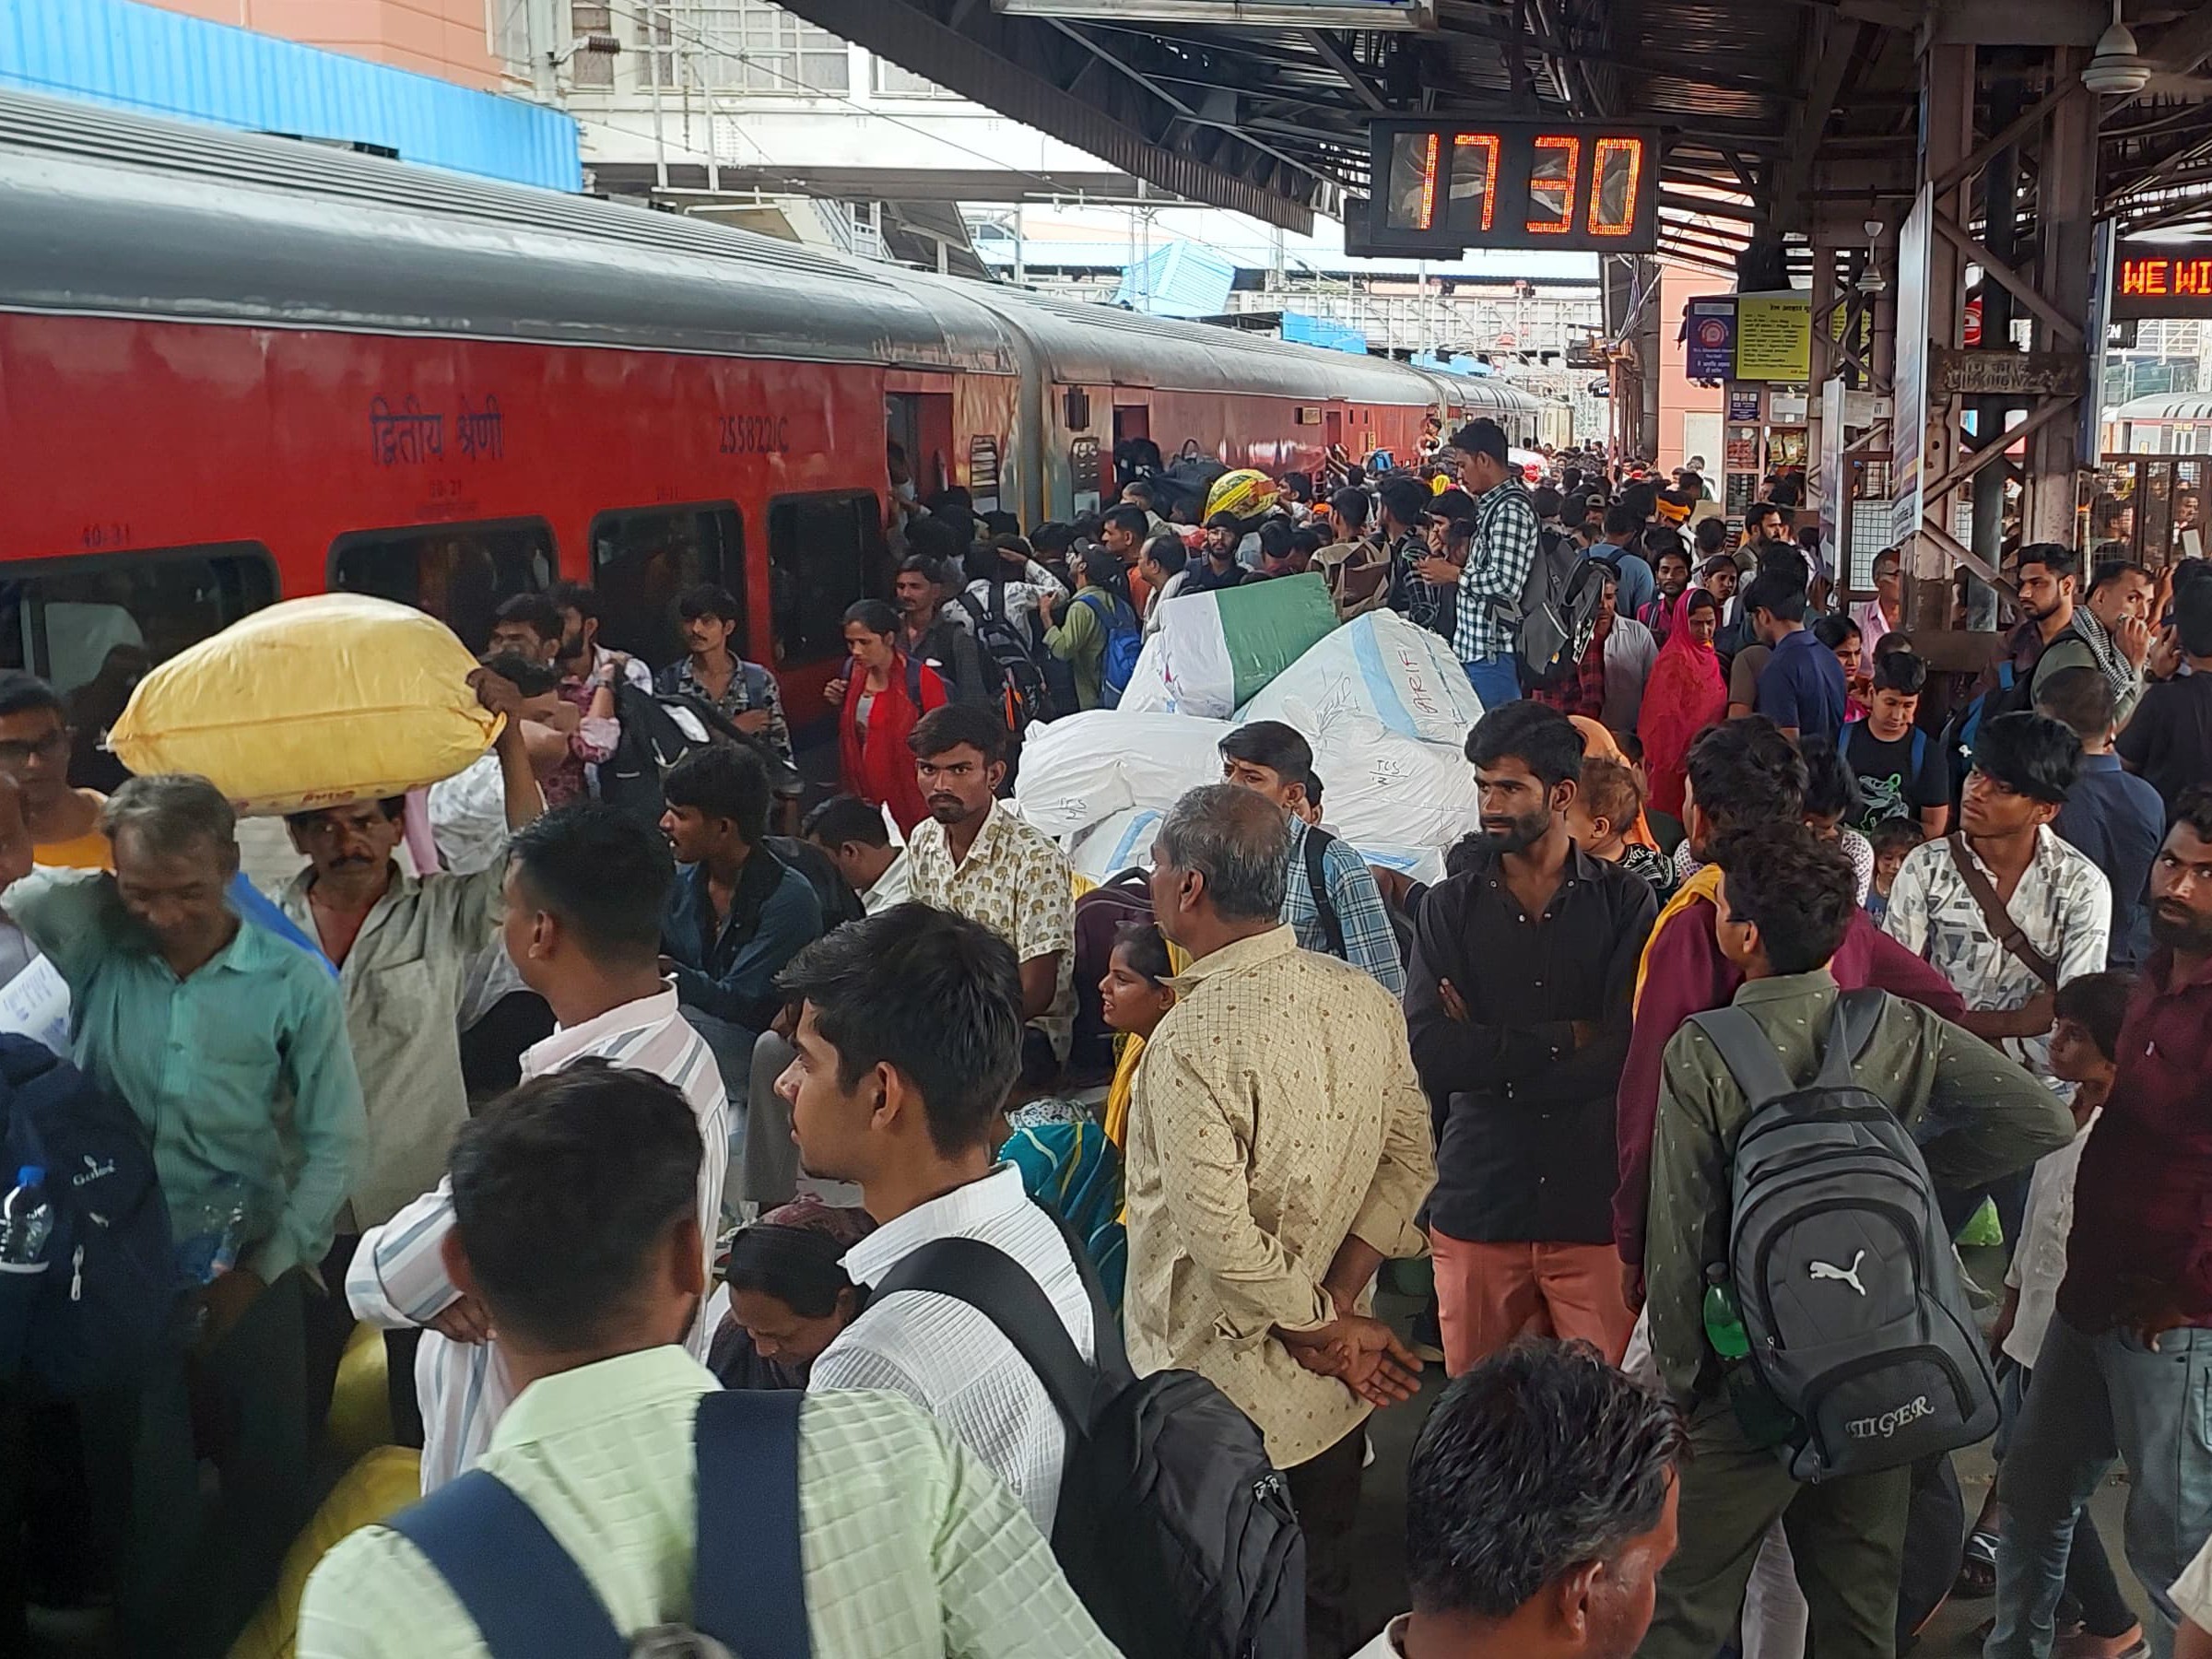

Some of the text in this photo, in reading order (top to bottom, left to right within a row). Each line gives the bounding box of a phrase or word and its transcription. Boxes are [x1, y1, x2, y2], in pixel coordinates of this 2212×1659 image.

[2122, 259, 2212, 294] WE WI
[371, 393, 504, 465] द्वितीय श्रेणी
[1397, 649, 1439, 715] ARIF
[1845, 1394, 1935, 1438] TIGER
